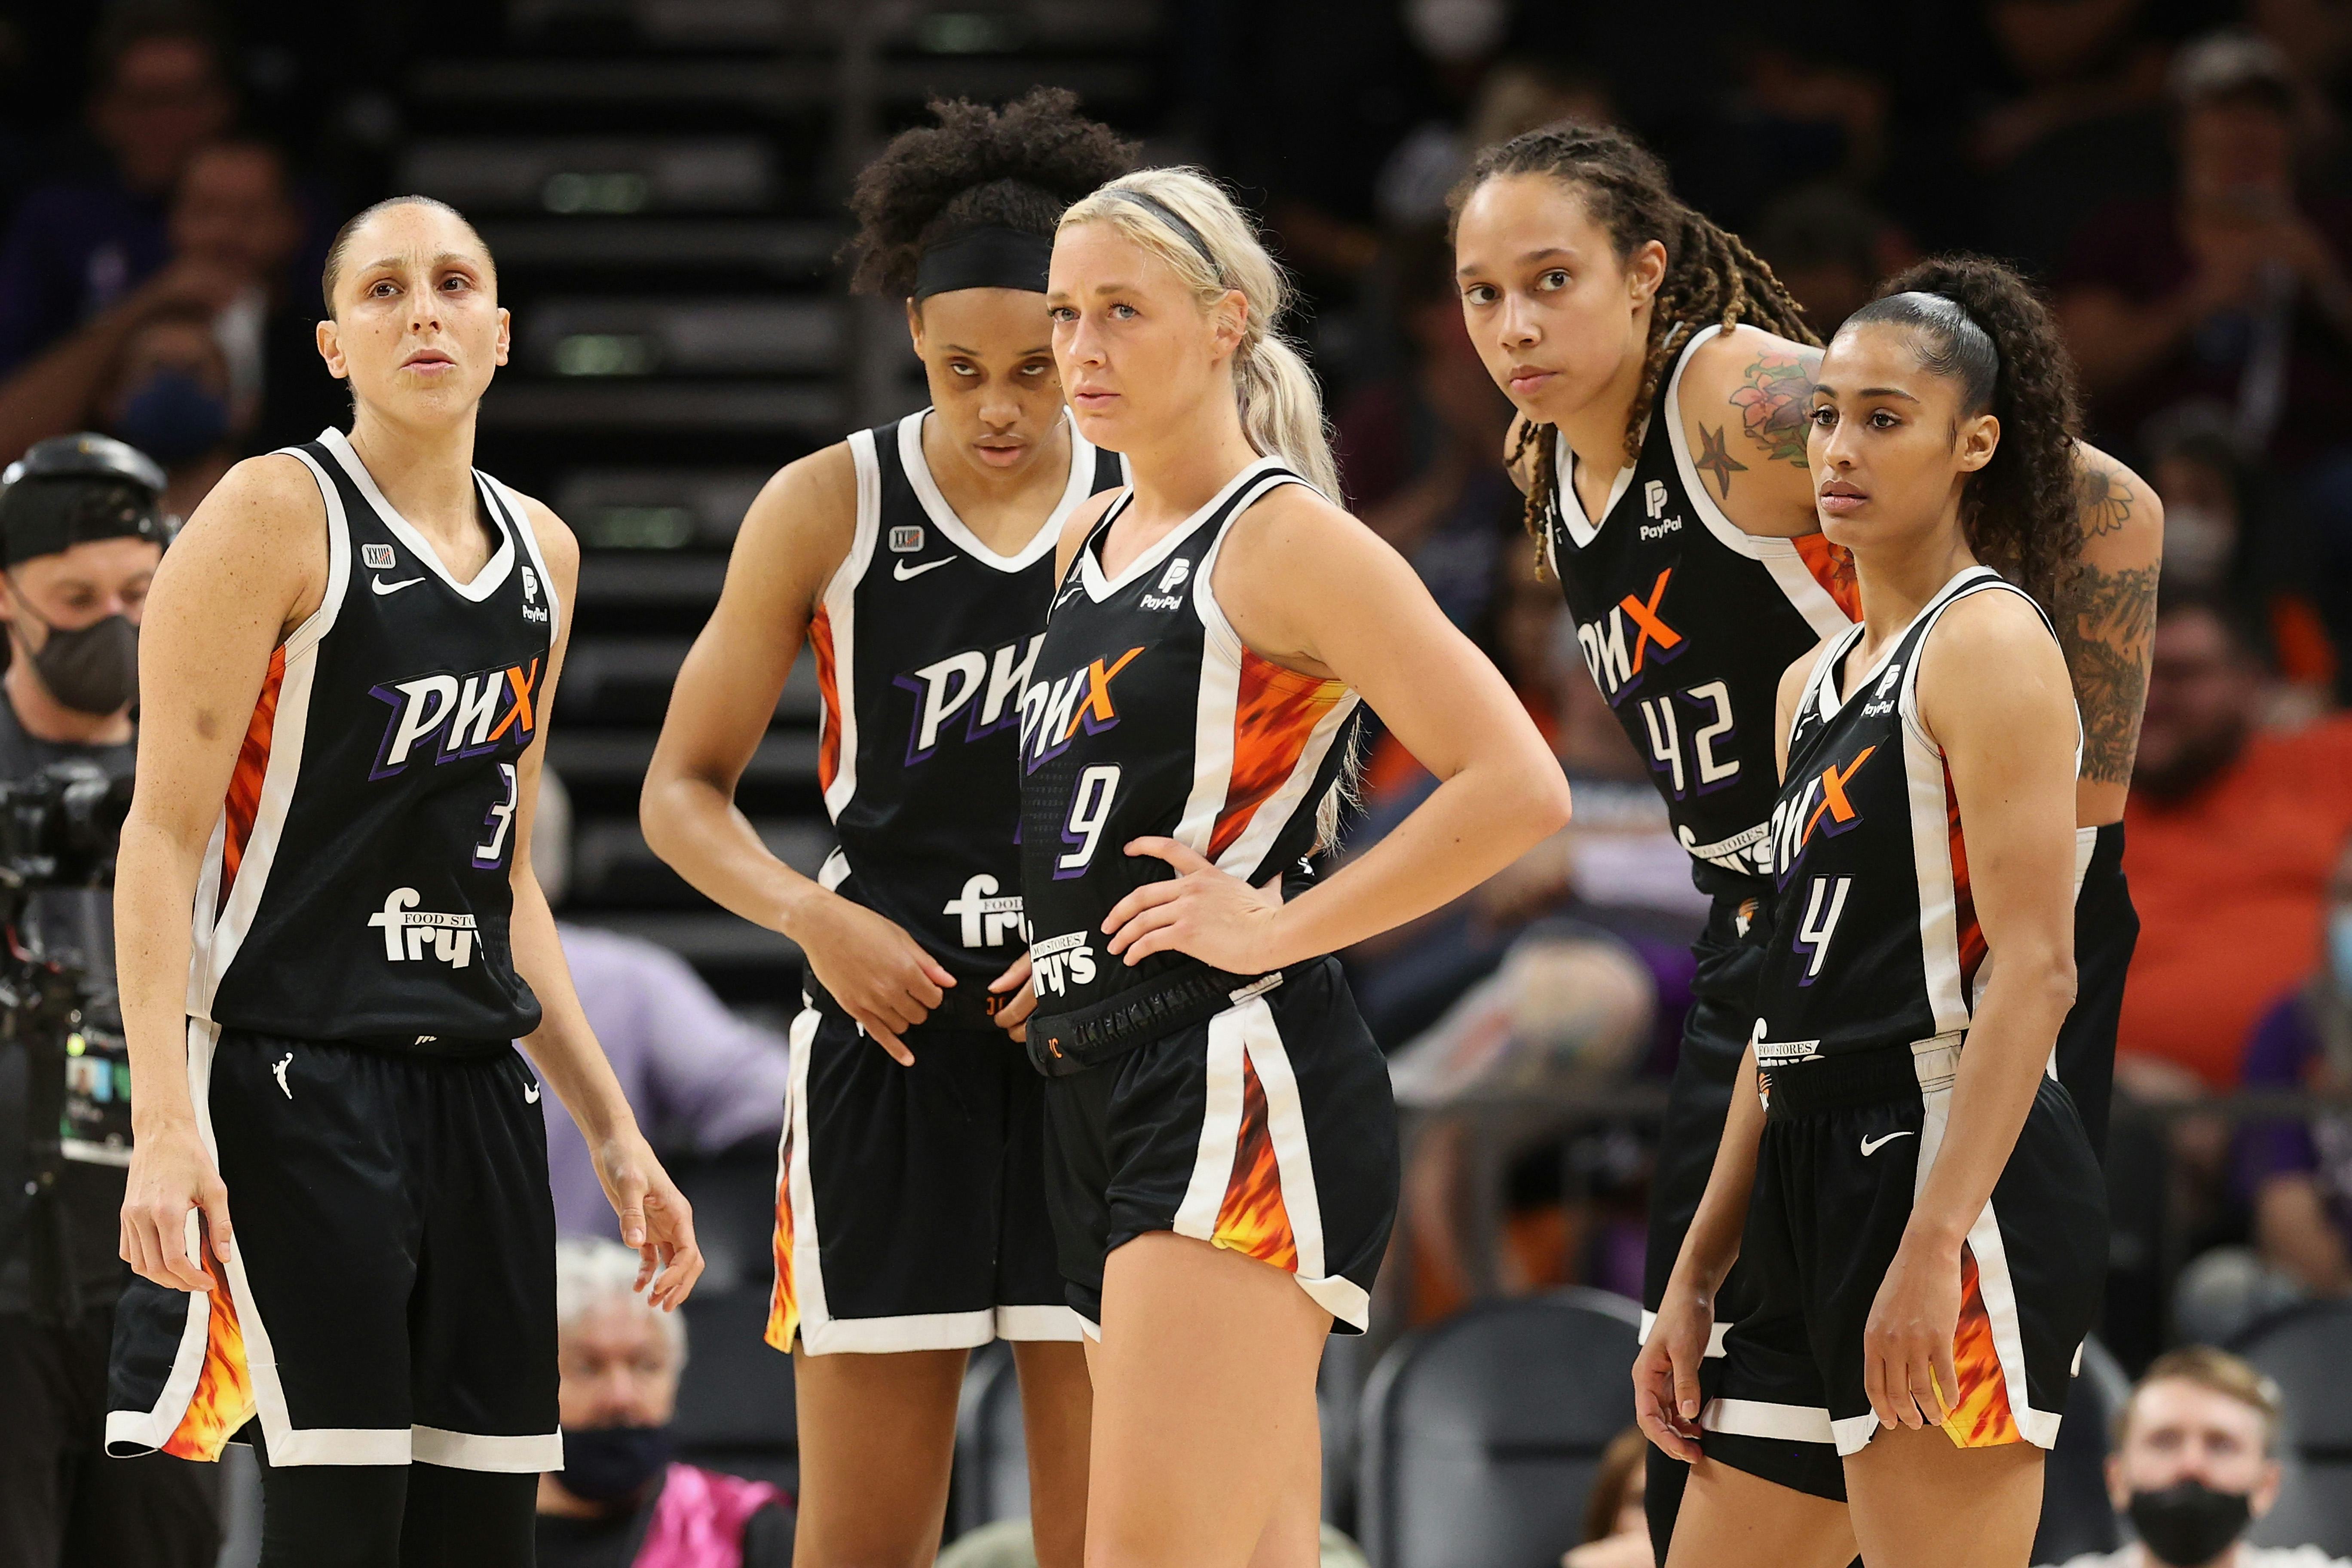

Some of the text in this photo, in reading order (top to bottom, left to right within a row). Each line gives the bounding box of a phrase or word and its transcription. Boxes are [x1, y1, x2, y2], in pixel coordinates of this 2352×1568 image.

[1640, 515, 1682, 541] PayPal
[522, 605, 547, 622] PayPal
[1140, 594, 1182, 610] PayPal
[387, 657, 538, 765] PHX
[914, 632, 1047, 750] PH
[1641, 680, 1740, 791] 42
[476, 763, 517, 860] 3
[1060, 766, 1120, 868] 9
[368, 887, 484, 968] fry
[405, 914, 444, 924] FOOD
[1047, 935, 1081, 952] STORES
[1800, 878, 1851, 976] 4
